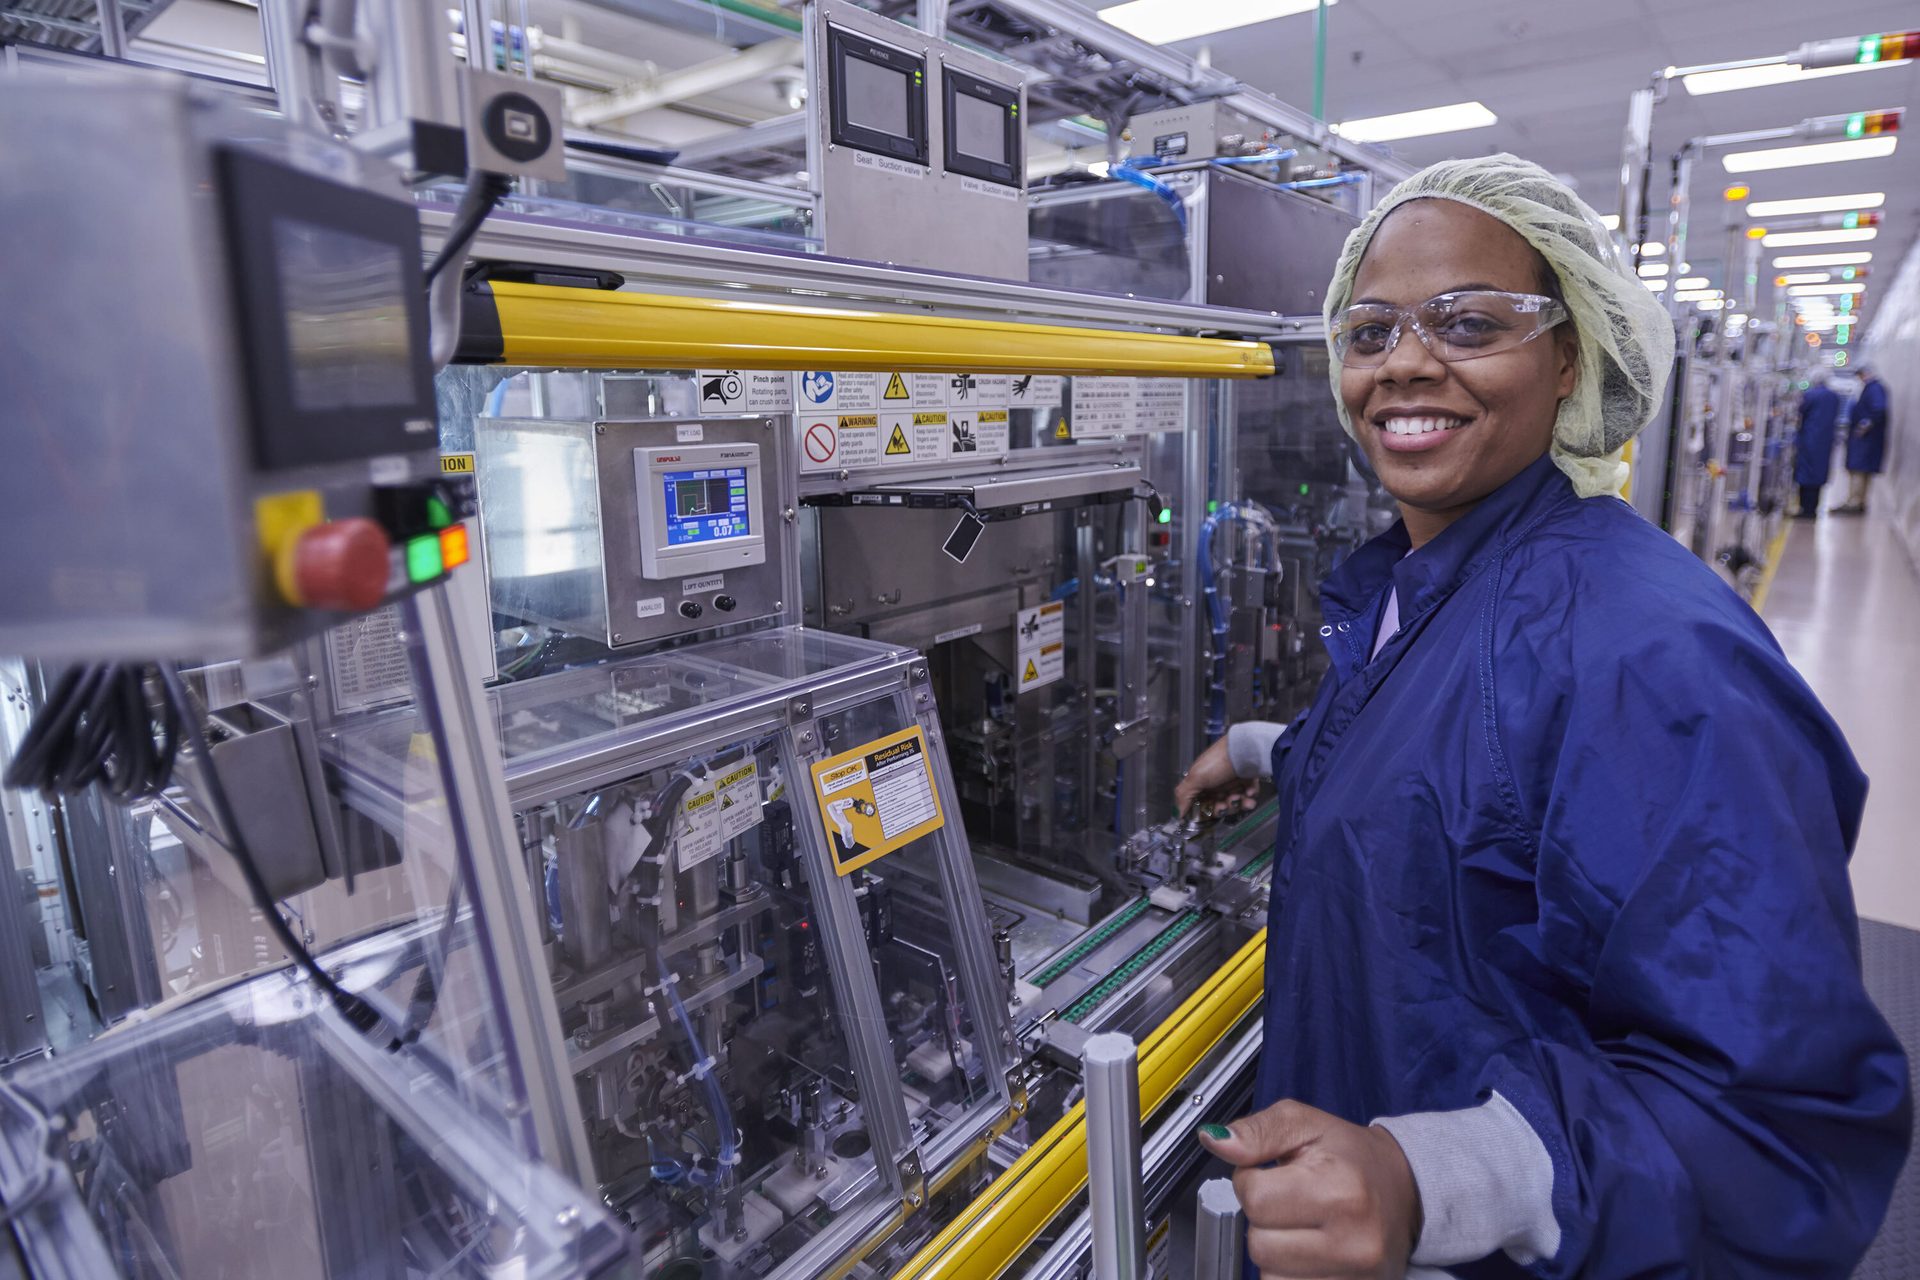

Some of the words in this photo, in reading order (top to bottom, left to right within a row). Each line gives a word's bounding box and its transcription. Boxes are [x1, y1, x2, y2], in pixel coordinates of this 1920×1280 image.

[856, 154, 872, 166] Seat
[878, 158, 902, 173] Suction
[903, 166, 921, 176] valve
[963, 180, 979, 190] Valve
[982, 184, 1002, 195] Suction
[1002, 188, 1017, 198] valve
[770, 376, 785, 384] point
[752, 388, 774, 396] Rotating
[848, 416, 877, 426] WARNING
[922, 413, 946, 423] CAUTION
[984, 412, 1007, 421] CAUTION
[440, 458, 466, 470] ION
[714, 526, 732, 537] 0.07
[874, 747, 900, 762] Residual
[900, 742, 914, 752] Risk
[876, 759, 886, 767] After
[886, 750, 909, 765] Performing
[726, 766, 752, 784] CAUTION
[830, 770, 845, 780] Stop
[846, 764, 858, 774] OK
[687, 792, 715, 810] CAUTION
[723, 814, 734, 824] OPEN
[735, 810, 746, 819] HAND
[746, 802, 758, 812] VALVE
[736, 810, 752, 823] RELEASE
[682, 842, 692, 851] OPEN
[694, 836, 705, 846] HAND
[706, 830, 718, 840] VALVE
[696, 840, 712, 852] RELEASE
